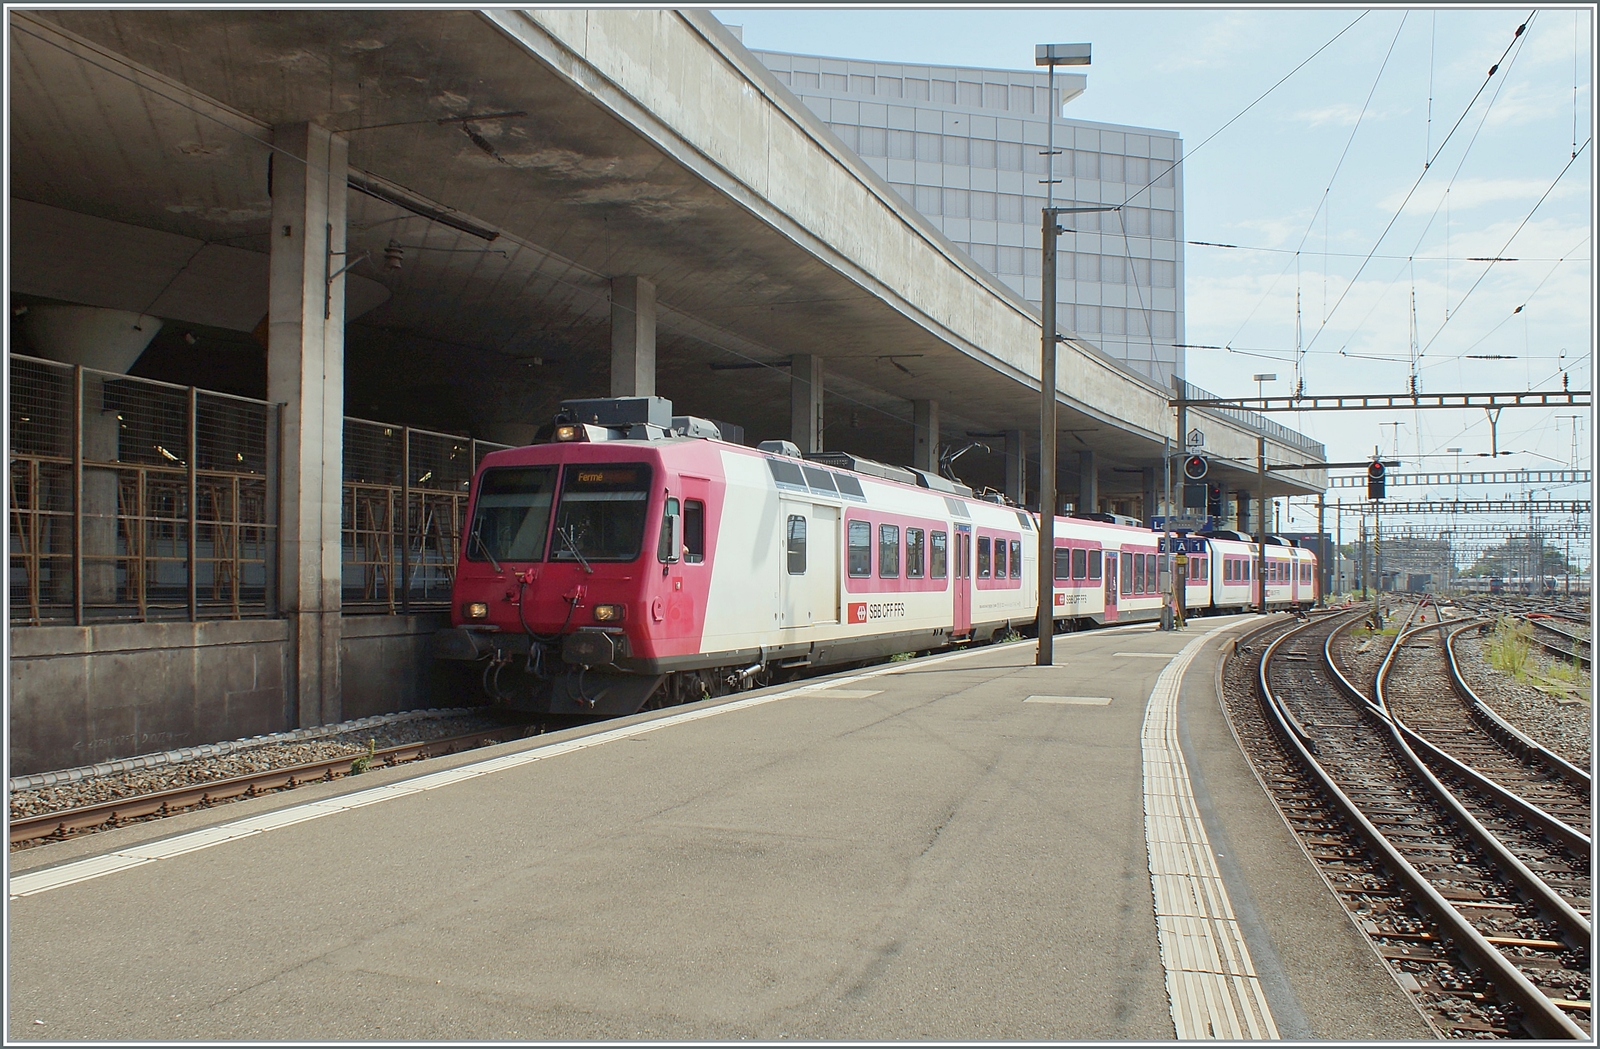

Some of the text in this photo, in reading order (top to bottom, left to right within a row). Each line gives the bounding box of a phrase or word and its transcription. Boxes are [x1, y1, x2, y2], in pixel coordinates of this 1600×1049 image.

[1191, 433, 1199, 443] 4
[578, 472, 603, 481] Fermé
[1178, 543, 1186, 551] A
[1196, 543, 1201, 551] 1
[869, 602, 905, 619] SBB CFF FFS
